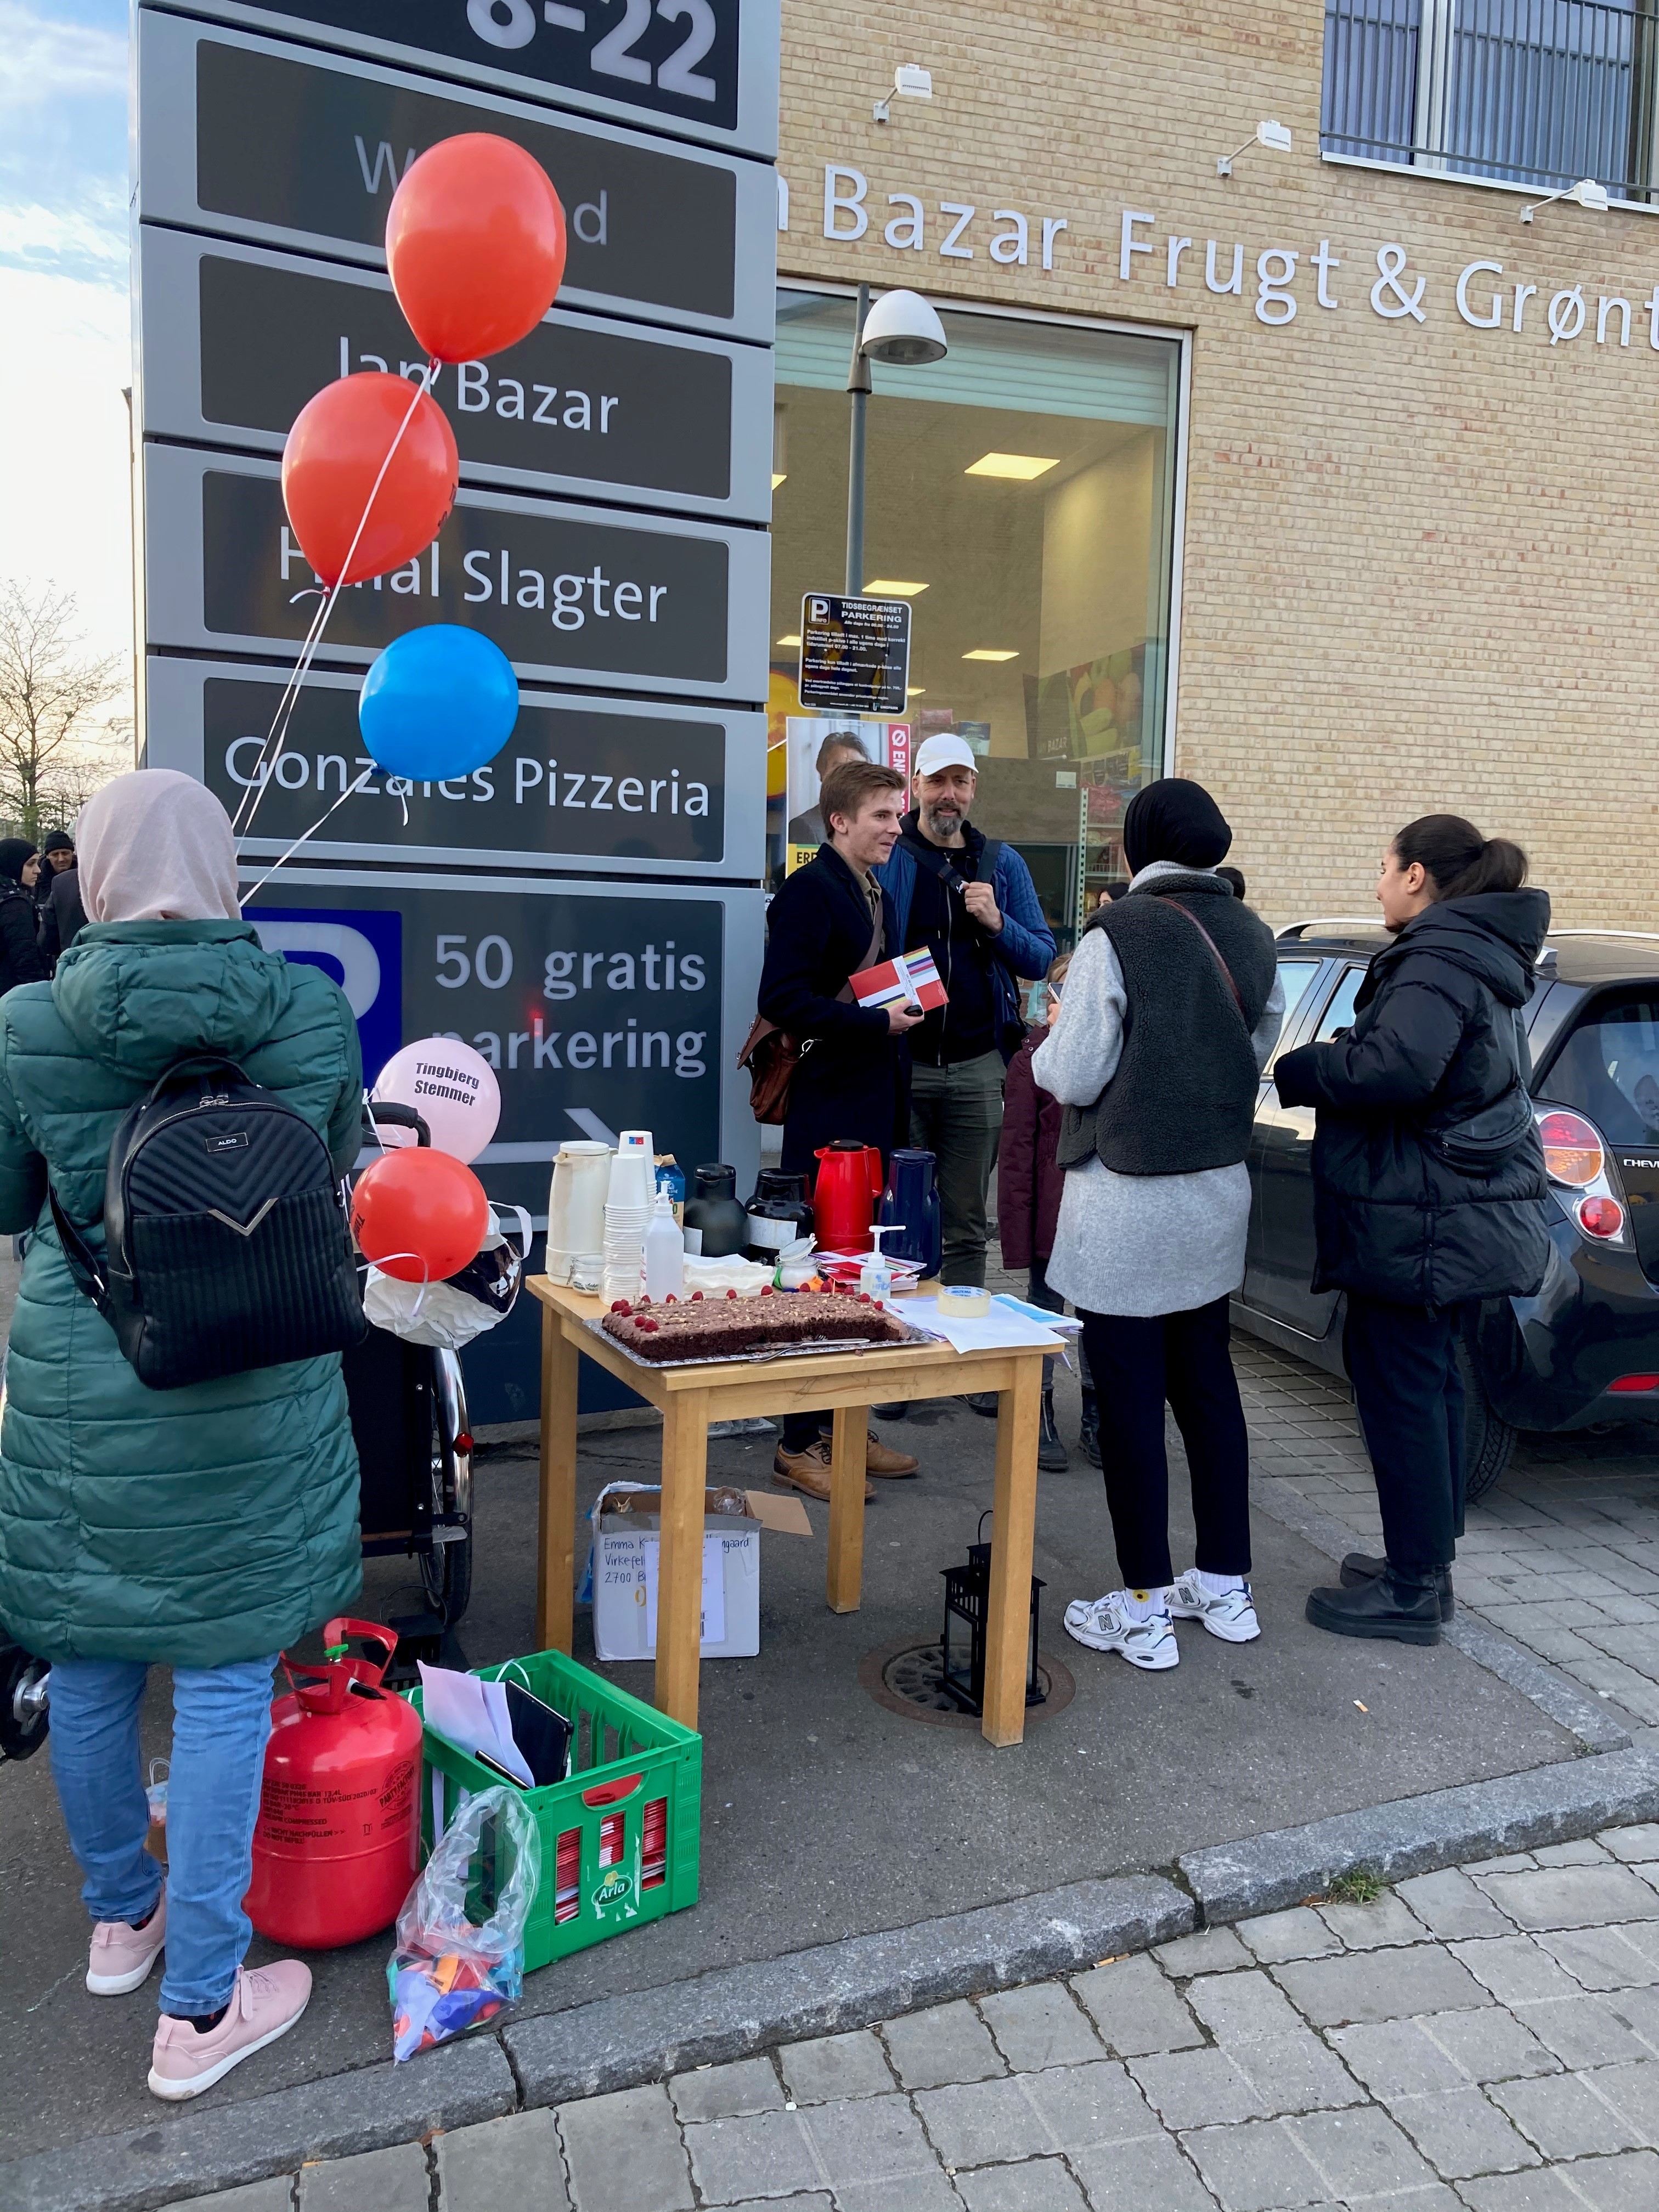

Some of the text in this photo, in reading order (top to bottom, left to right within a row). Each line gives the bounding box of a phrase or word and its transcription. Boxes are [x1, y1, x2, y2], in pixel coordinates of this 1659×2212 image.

[824, 164, 1068, 270] Bazar
[1119, 210, 1341, 326] Frugt
[1370, 243, 1426, 323] &
[458, 360, 619, 435] Bazar
[462, 549, 667, 631] Slagter
[841, 611, 902, 623] PARKERING
[842, 601, 902, 614] TIDSBEGRÆNSET
[515, 757, 710, 817] Pizzeria
[435, 934, 514, 990] 50
[543, 940, 707, 1001] gratis
[432, 1017, 707, 1077] arkering
[416, 1062, 480, 1090] Tingbjerg
[414, 1080, 476, 1106] Stemmer
[604, 1537, 634, 1550] Emma
[605, 1572, 631, 1584] 2700
[1178, 1587, 1195, 1604] N
[1098, 1613, 1114, 1632] N
[379, 1787, 397, 1808] PARTY
[599, 1882, 625, 1901] Arla
